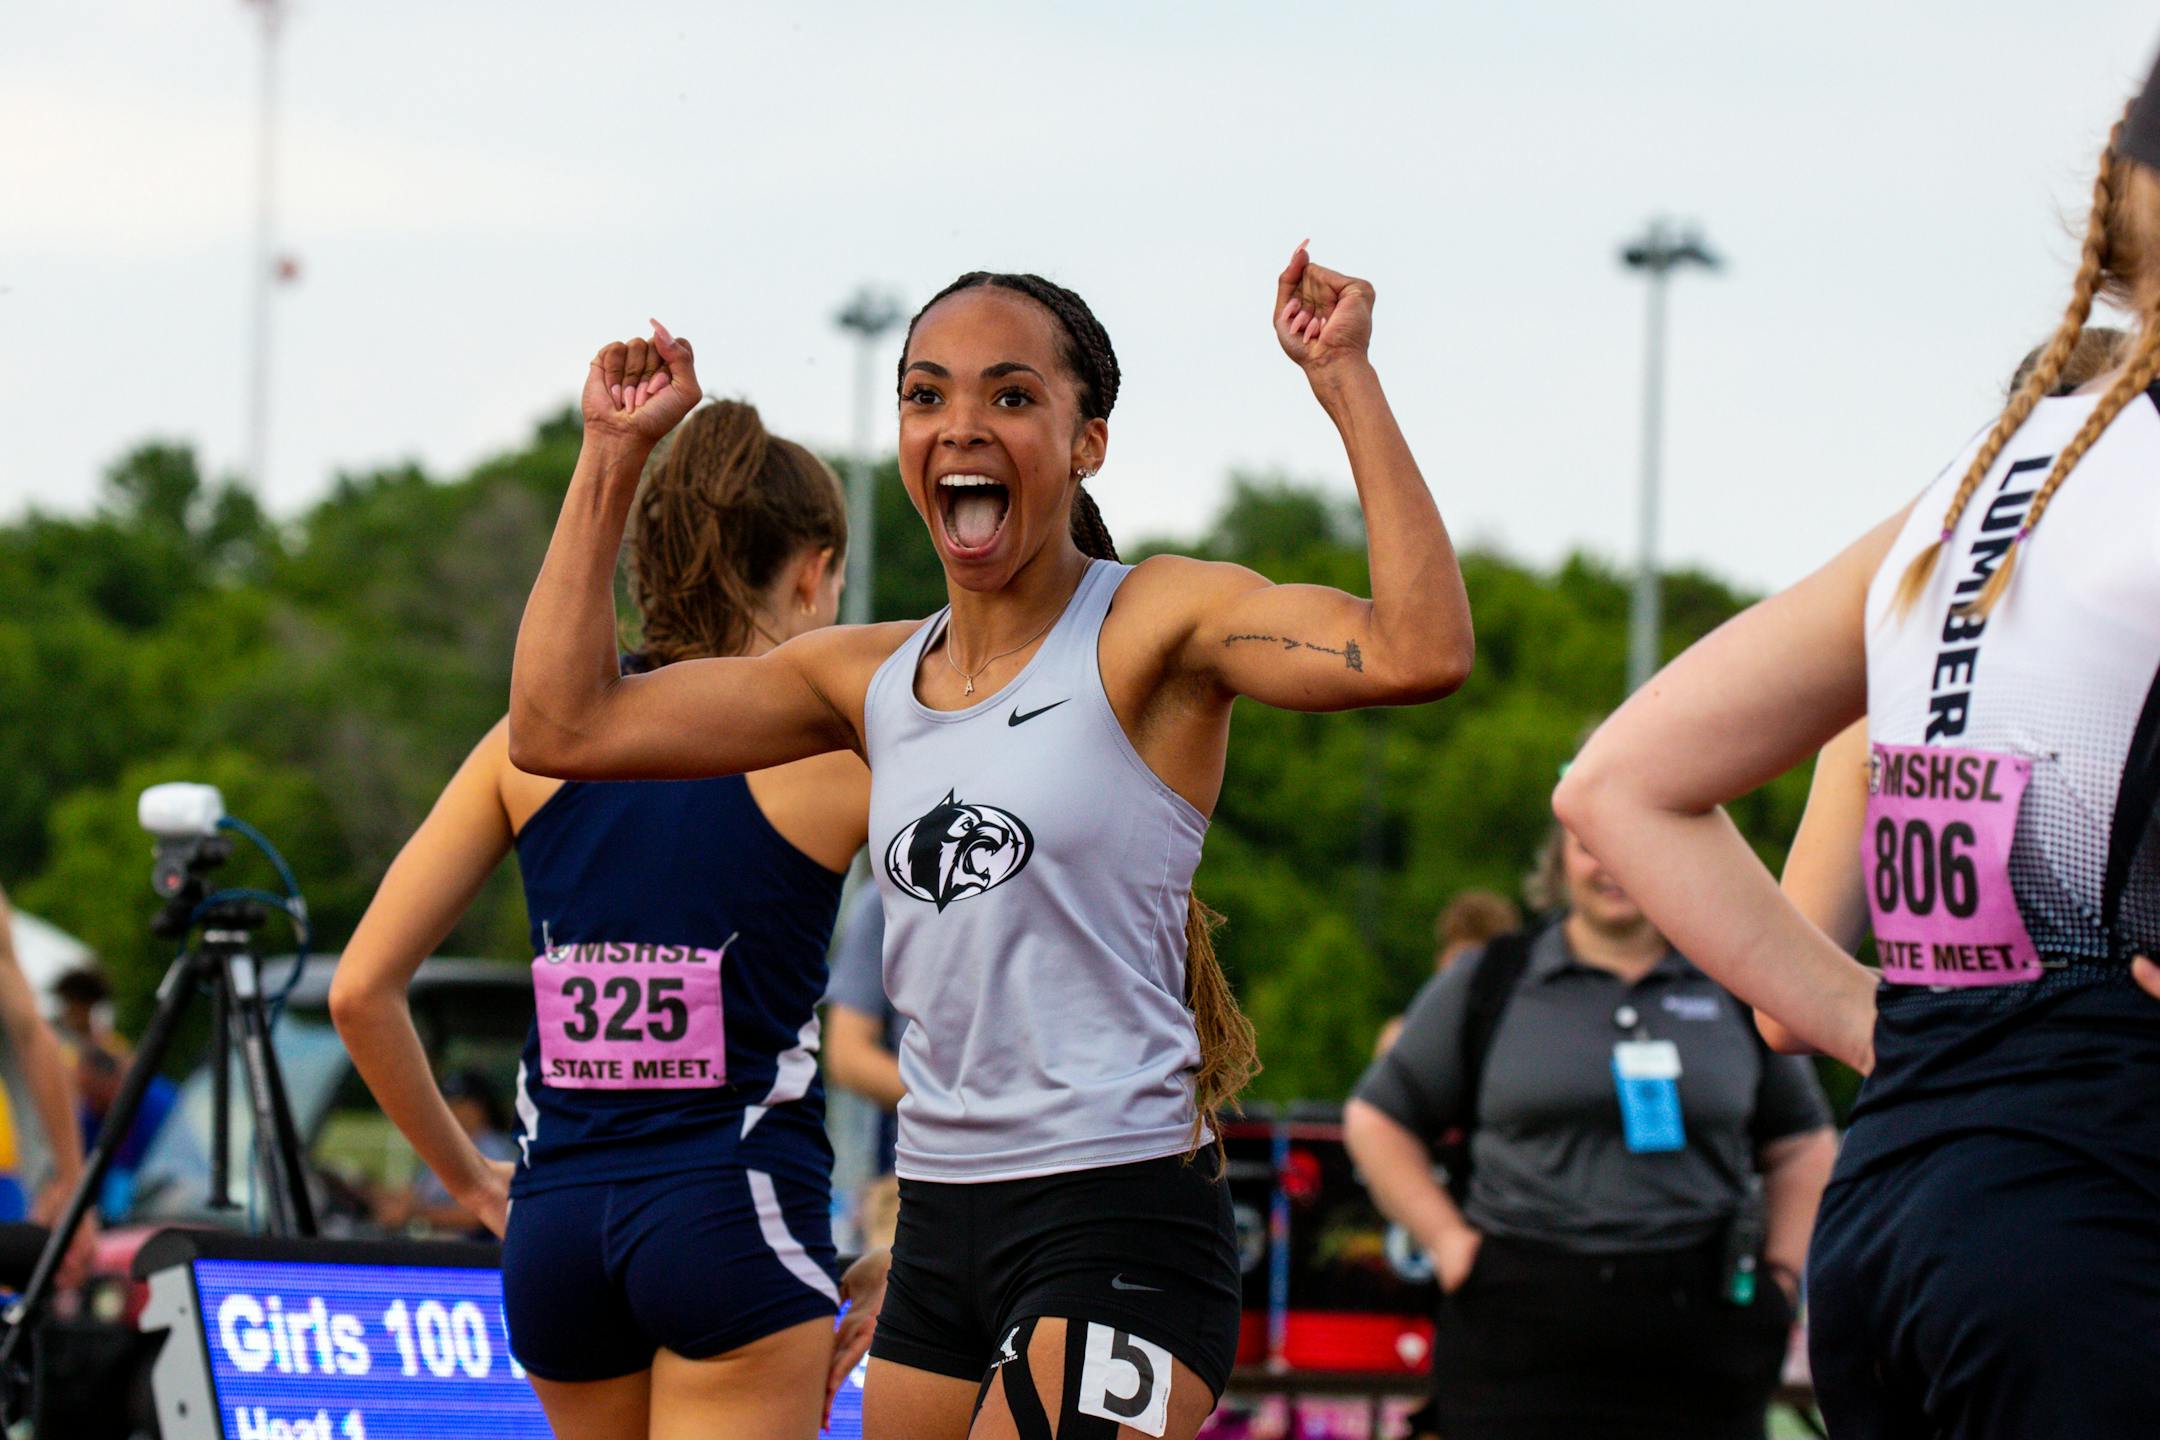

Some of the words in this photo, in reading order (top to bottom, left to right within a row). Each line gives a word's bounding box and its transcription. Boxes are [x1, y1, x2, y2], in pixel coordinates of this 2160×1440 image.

[1925, 454, 2052, 743] LUMBER
[1884, 752, 2004, 802] MSHSL
[1875, 815, 1980, 920] 806
[1876, 939, 1924, 970] TATE
[561, 976, 689, 1043] 325
[552, 1058, 623, 1080] STATE
[217, 1293, 372, 1375] Girls
[384, 1298, 493, 1378] 100
[1102, 1328, 1154, 1419] 5
